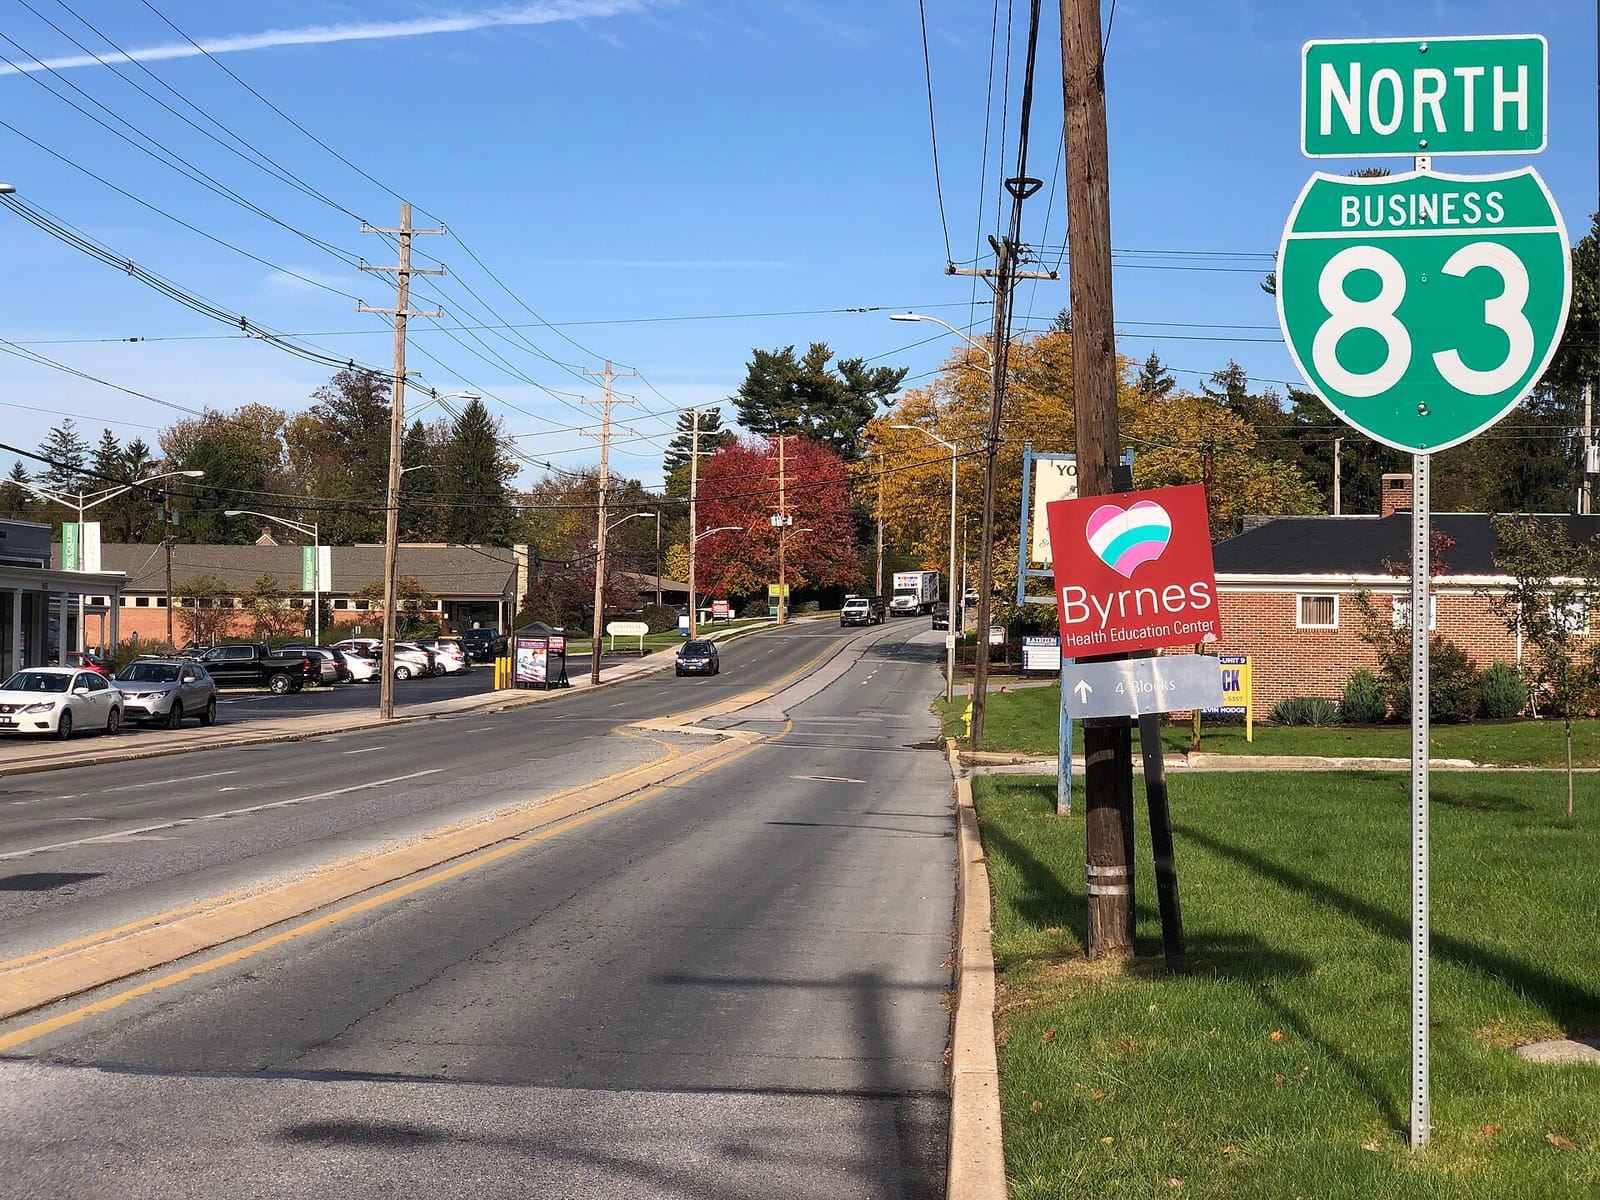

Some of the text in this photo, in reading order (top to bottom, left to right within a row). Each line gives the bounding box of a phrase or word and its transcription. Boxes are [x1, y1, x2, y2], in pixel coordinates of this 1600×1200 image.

[1319, 62, 1529, 136] NORTH
[1341, 191, 1505, 228] BUSINESS
[1312, 241, 1535, 398] 83
[1056, 464, 1077, 477] YO
[1062, 581, 1211, 630] Byrnes
[1066, 620, 1215, 648] Health Education Center
[1115, 677, 1176, 695] 4 Blocks
[1222, 669, 1240, 692] CK
